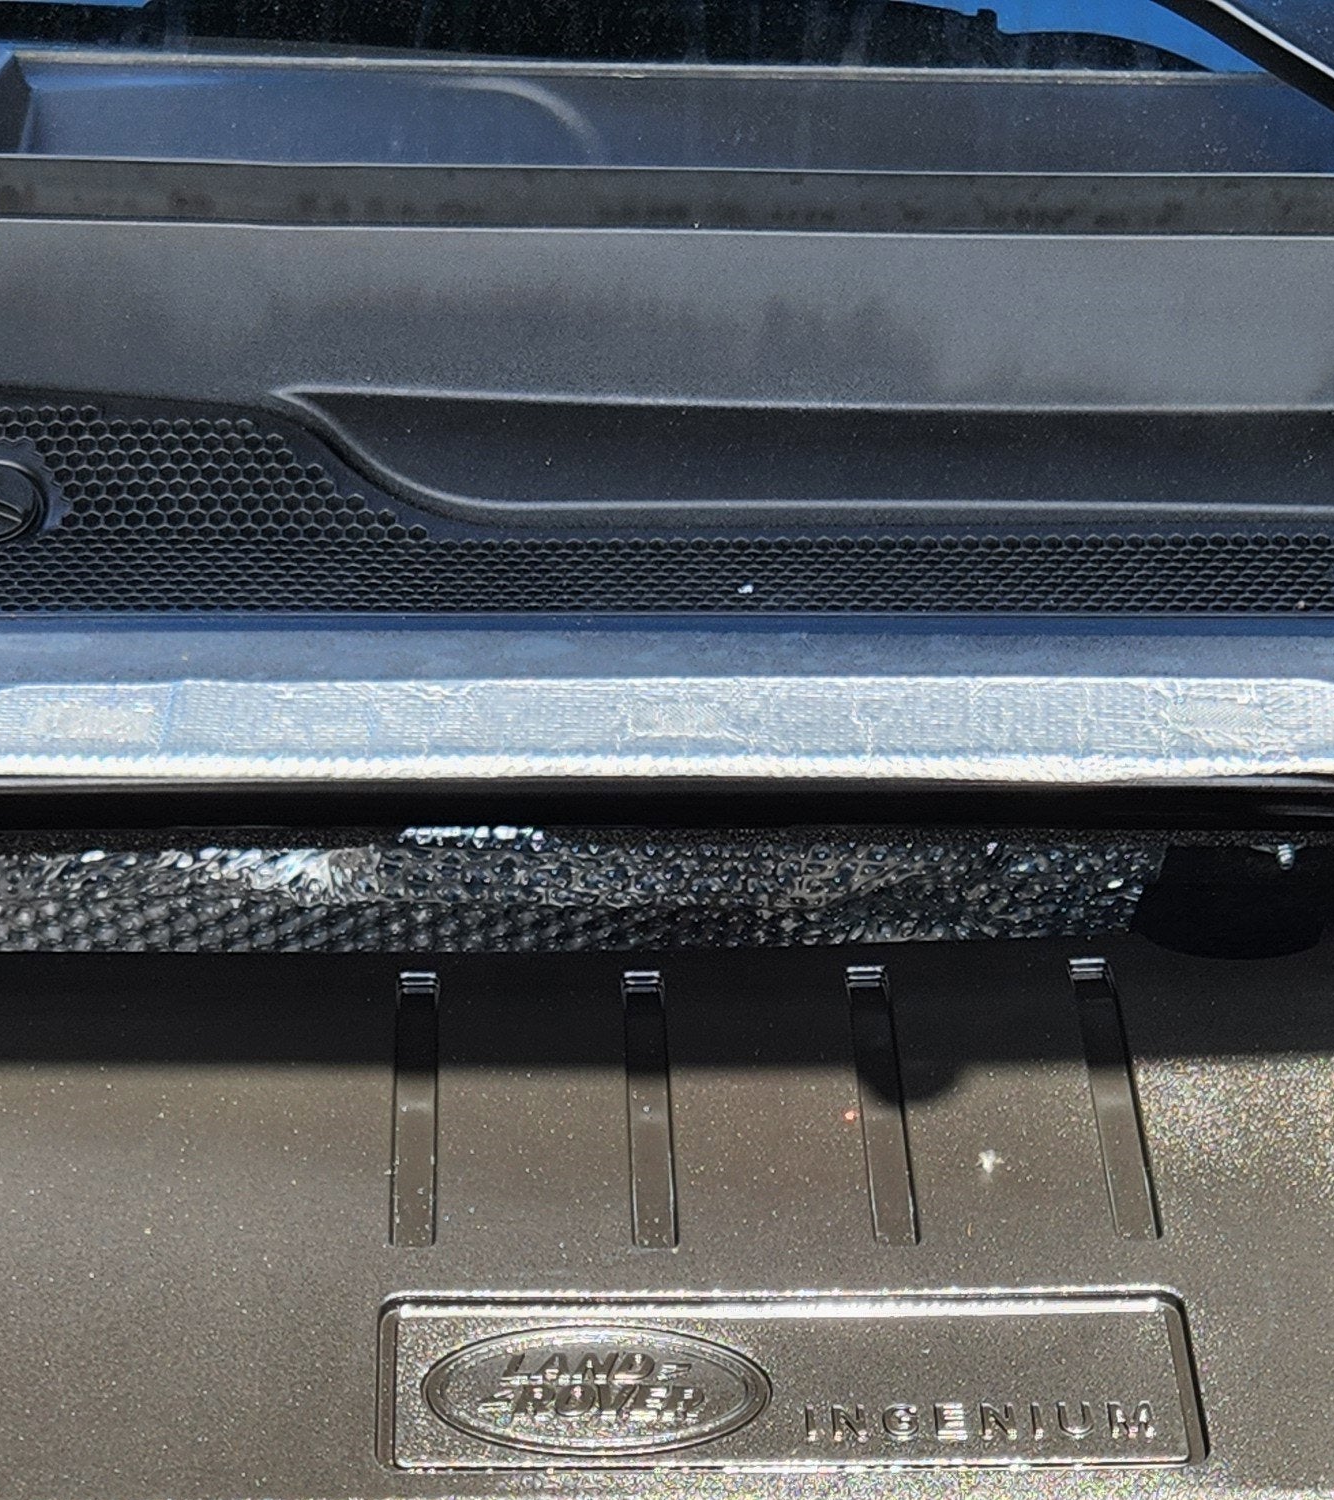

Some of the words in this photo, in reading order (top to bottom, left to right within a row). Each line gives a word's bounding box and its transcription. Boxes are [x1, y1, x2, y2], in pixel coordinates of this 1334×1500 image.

[502, 1353, 653, 1382] LAND
[510, 1384, 708, 1421] ROVER
[804, 1401, 1157, 1442] INGENIUM
